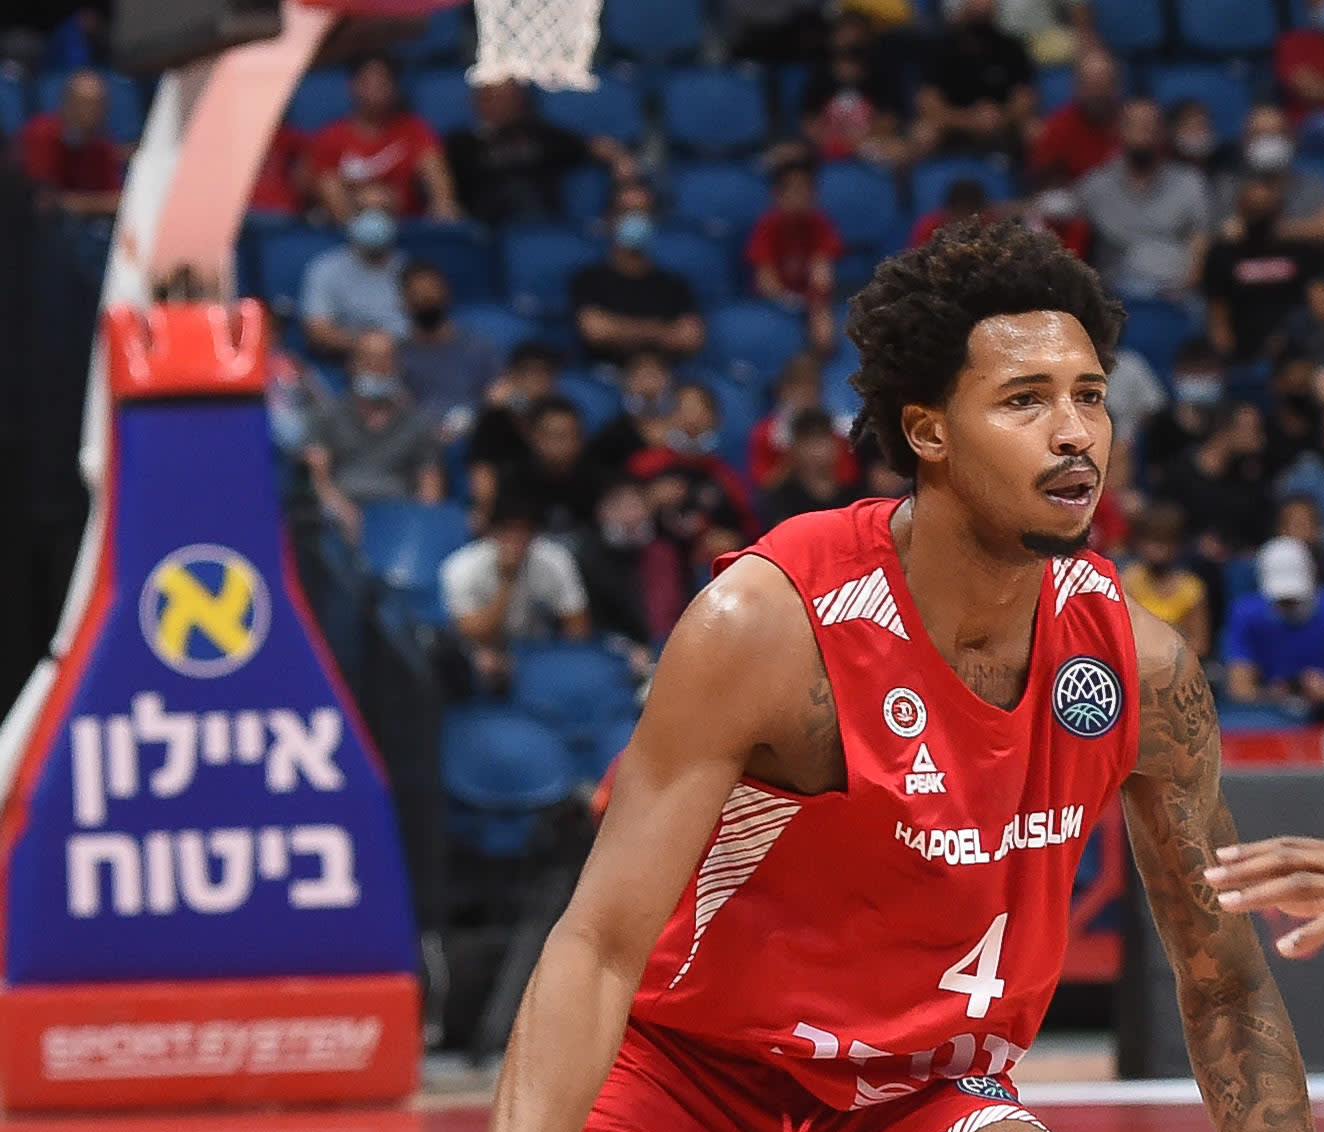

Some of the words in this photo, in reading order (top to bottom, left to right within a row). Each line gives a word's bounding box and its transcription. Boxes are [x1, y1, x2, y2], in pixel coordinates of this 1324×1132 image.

[70, 692, 346, 826] איילון
[905, 772, 947, 795] PEAK
[66, 823, 361, 918] ביטוח
[894, 821, 990, 866] HAPOEL
[937, 912, 1009, 1019] 4
